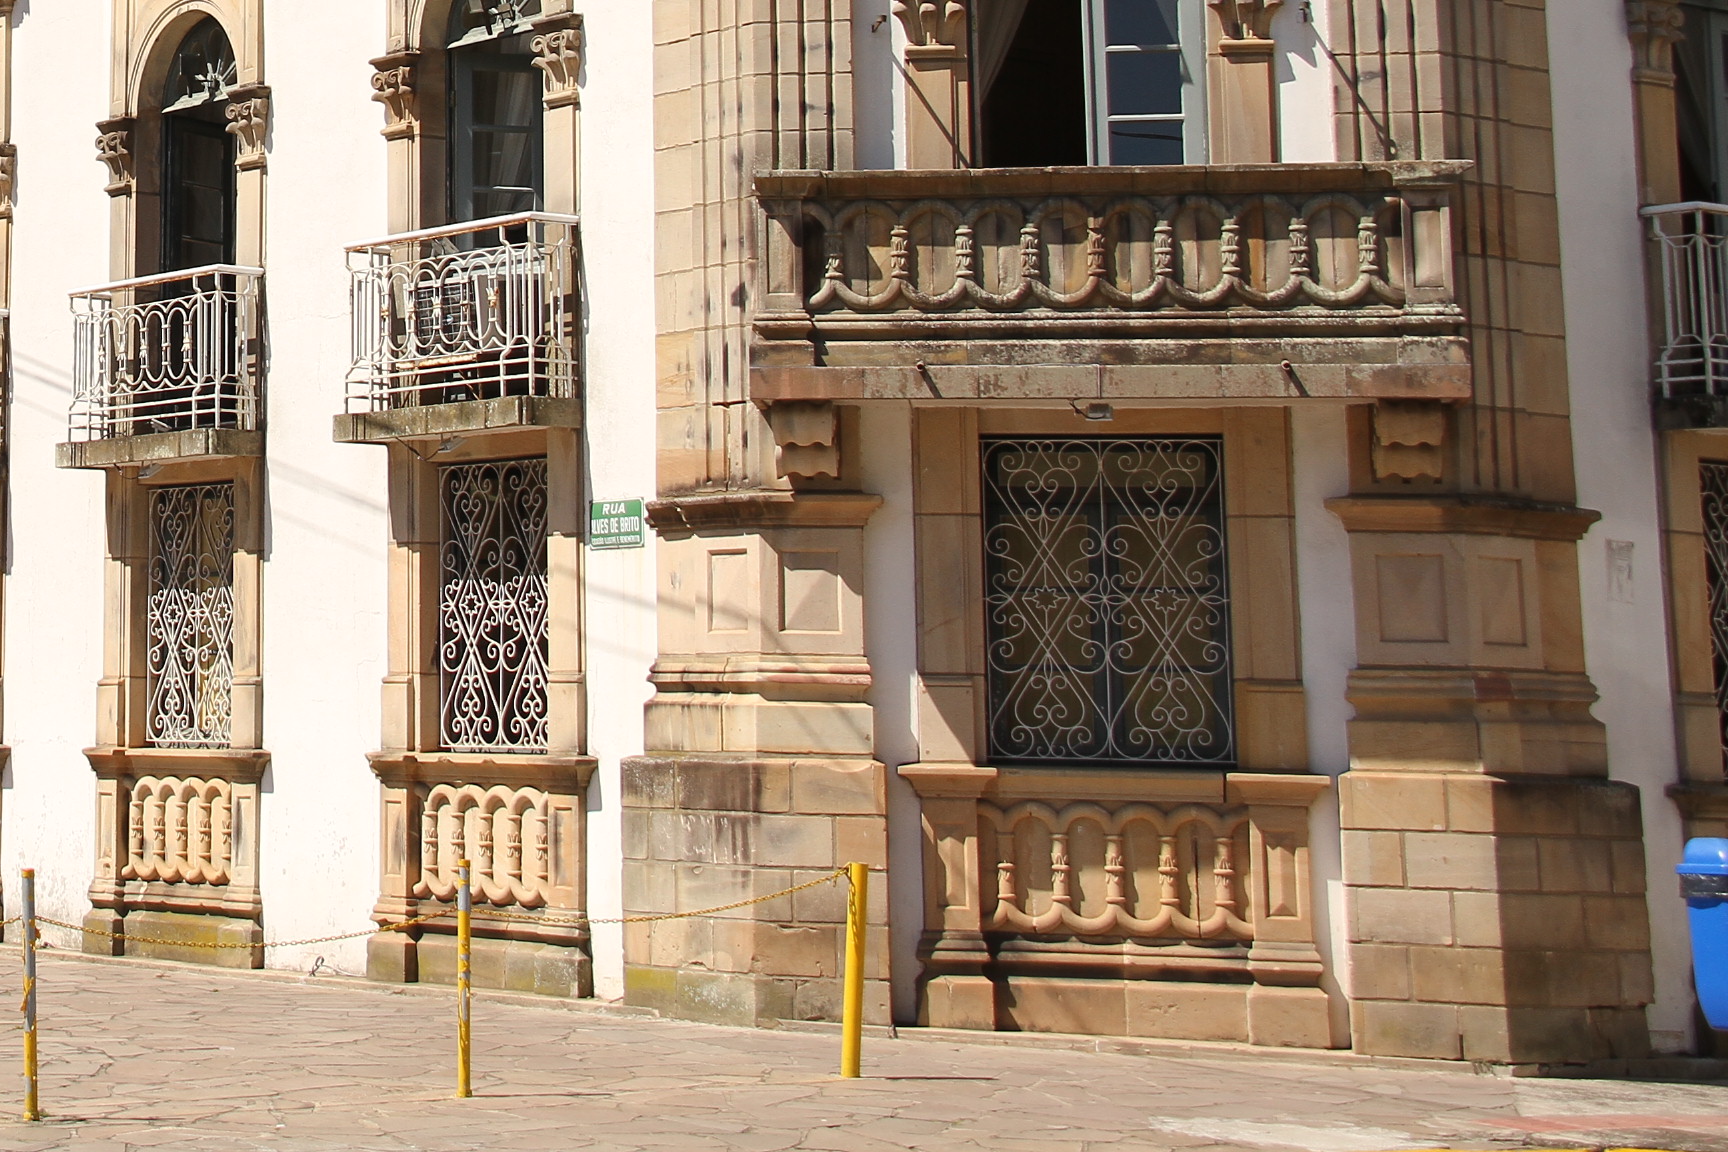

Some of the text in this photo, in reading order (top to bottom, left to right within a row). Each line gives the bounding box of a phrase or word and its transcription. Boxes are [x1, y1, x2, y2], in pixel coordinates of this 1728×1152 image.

[602, 502, 626, 515] RUA
[610, 517, 619, 533] DE
[620, 516, 640, 532] BRITO
